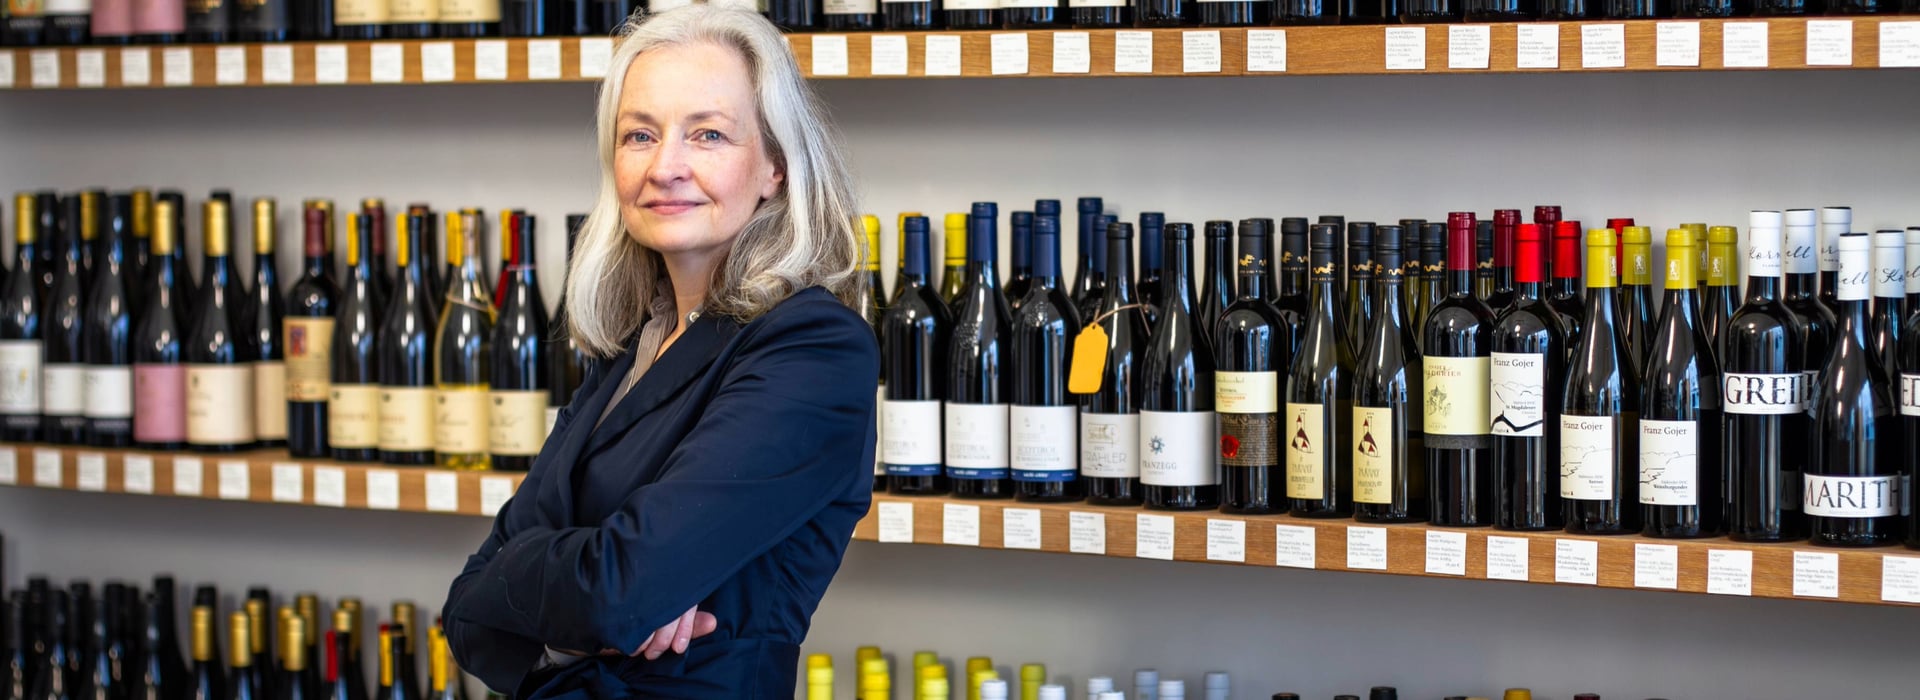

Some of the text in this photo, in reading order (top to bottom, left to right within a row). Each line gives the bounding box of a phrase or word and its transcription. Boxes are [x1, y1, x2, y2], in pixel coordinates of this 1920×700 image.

[1511, 358, 1534, 369] Gojer
[1580, 420, 1603, 432] Gojer
[1643, 425, 1687, 437] Franz Gojer
